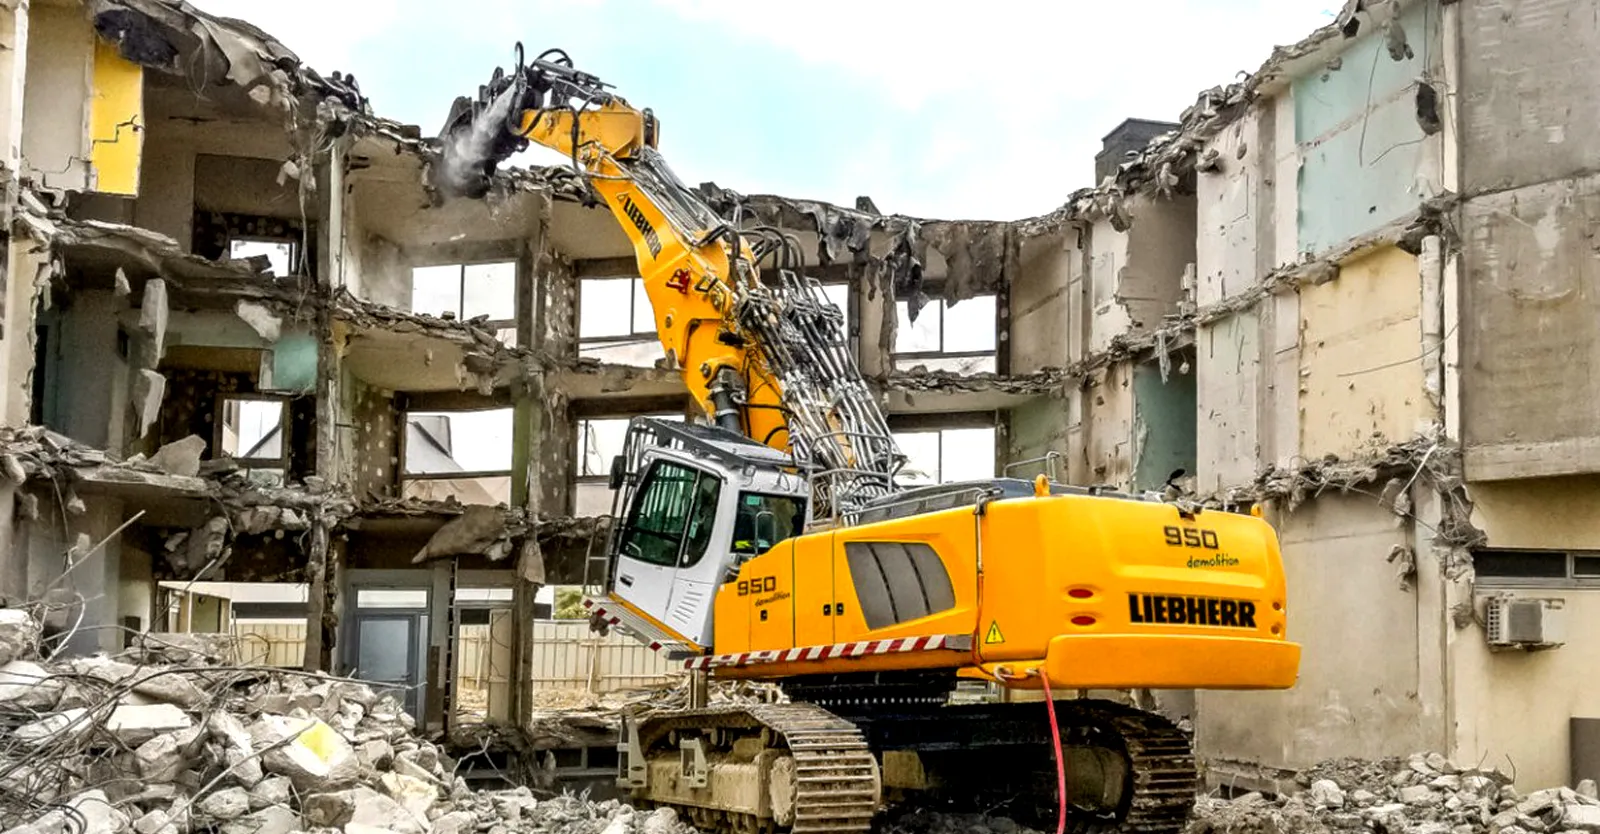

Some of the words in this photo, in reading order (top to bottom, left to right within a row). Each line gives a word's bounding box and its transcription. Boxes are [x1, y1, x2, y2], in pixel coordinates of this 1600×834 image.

[623, 198, 662, 261] LIEBHERR
[1164, 525, 1219, 549] 950
[1187, 554, 1239, 568] demolition
[738, 576, 776, 596] 950
[1128, 594, 1257, 628] LIEBHERR
